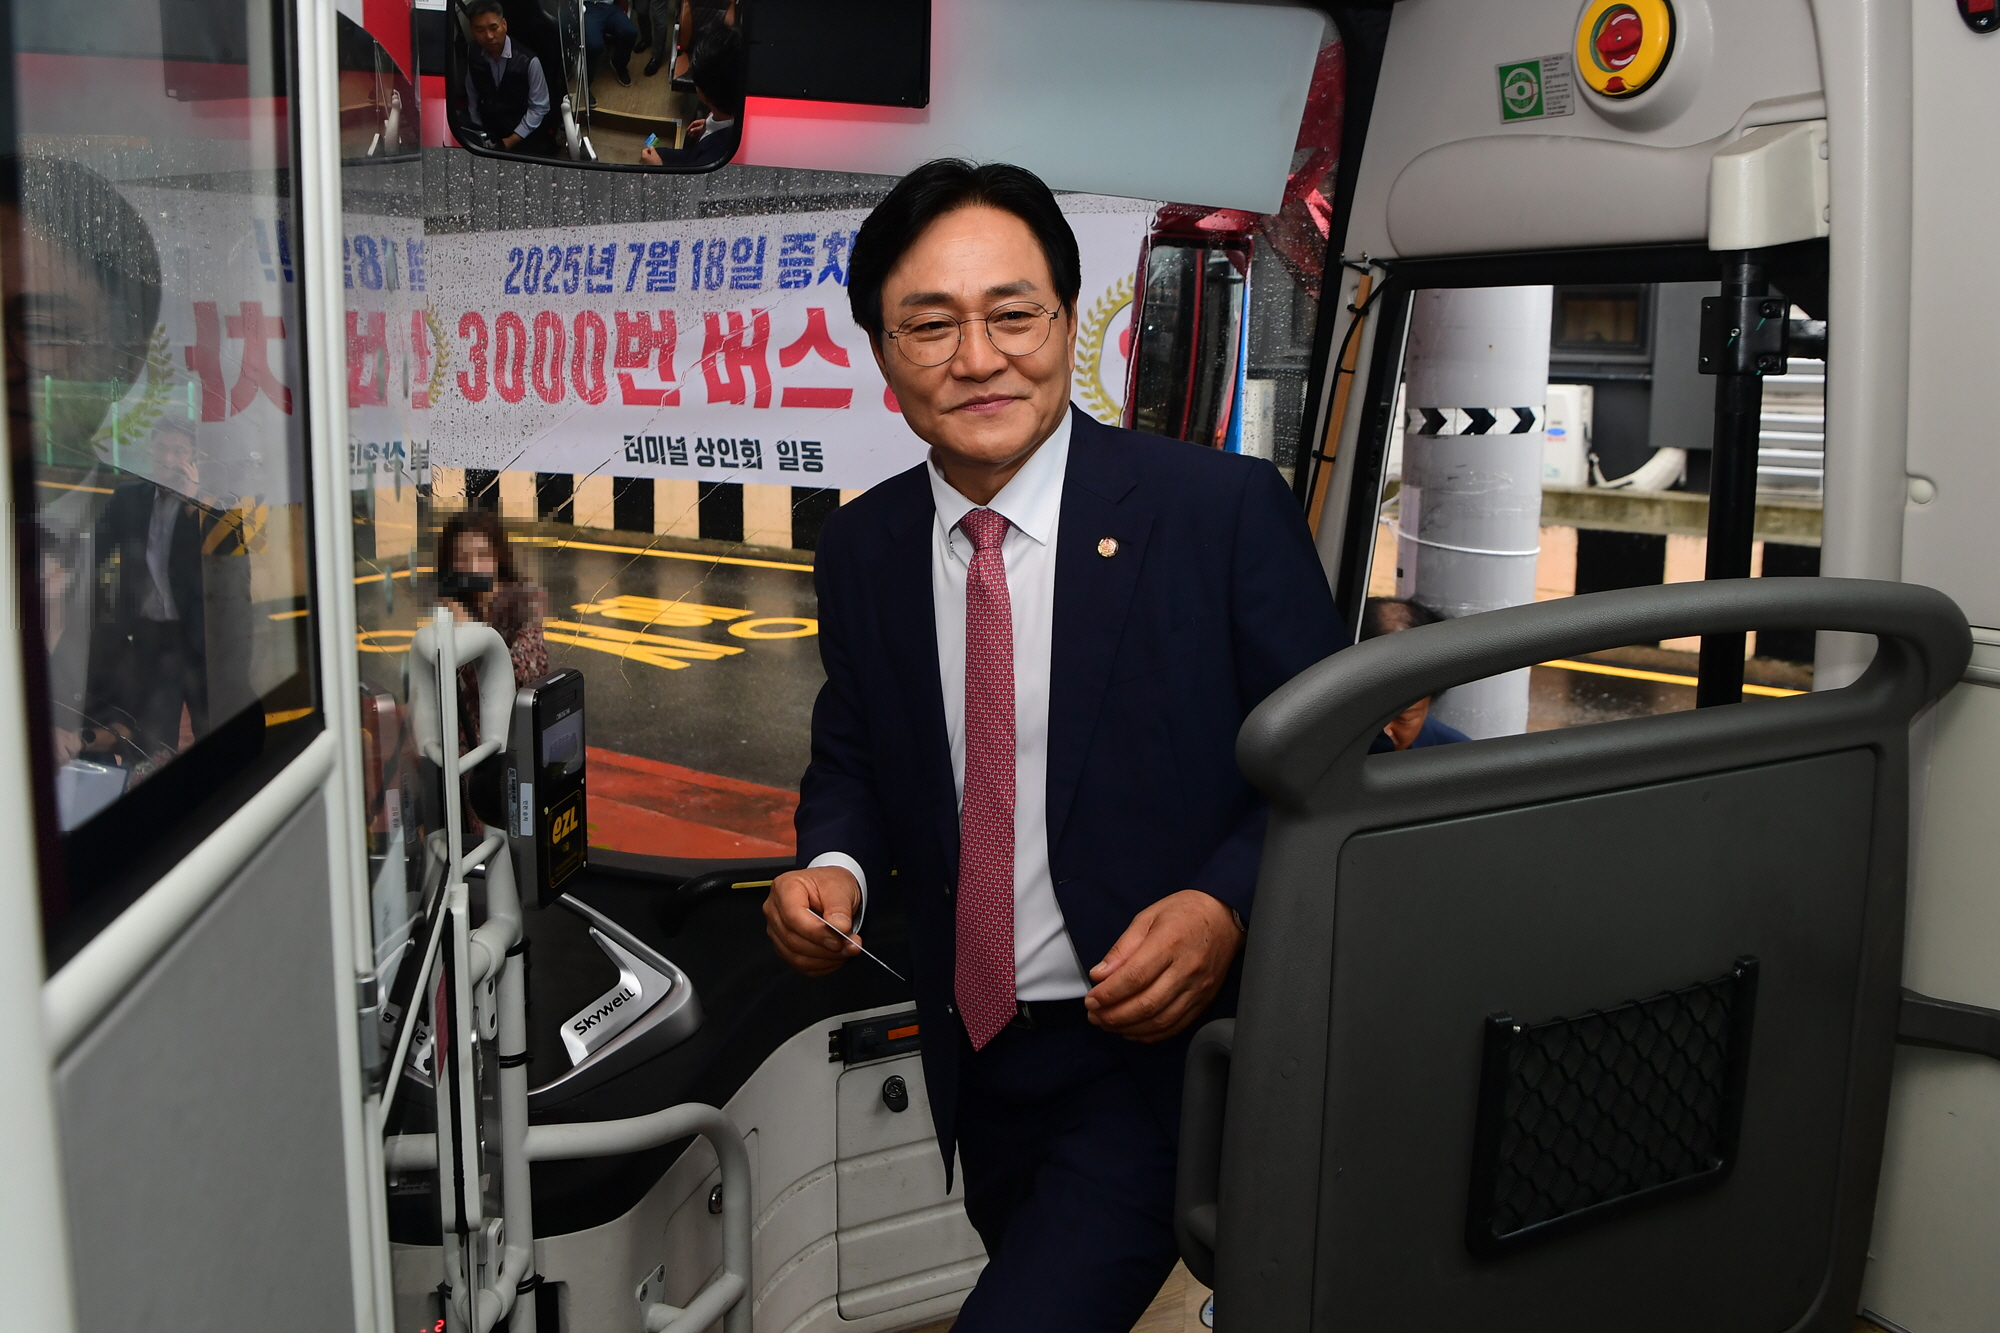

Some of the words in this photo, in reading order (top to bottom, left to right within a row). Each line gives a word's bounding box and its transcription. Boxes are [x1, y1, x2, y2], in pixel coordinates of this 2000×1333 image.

[504, 242, 616, 295] 2025년
[625, 239, 680, 293] 7월
[691, 235, 767, 291] 18일
[456, 309, 681, 407] 3000번
[701, 307, 854, 409] 버스
[623, 435, 689, 466] 터미널
[694, 437, 763, 470] 상인회
[776, 440, 824, 473] 일동
[573, 987, 636, 1036] Skywell
